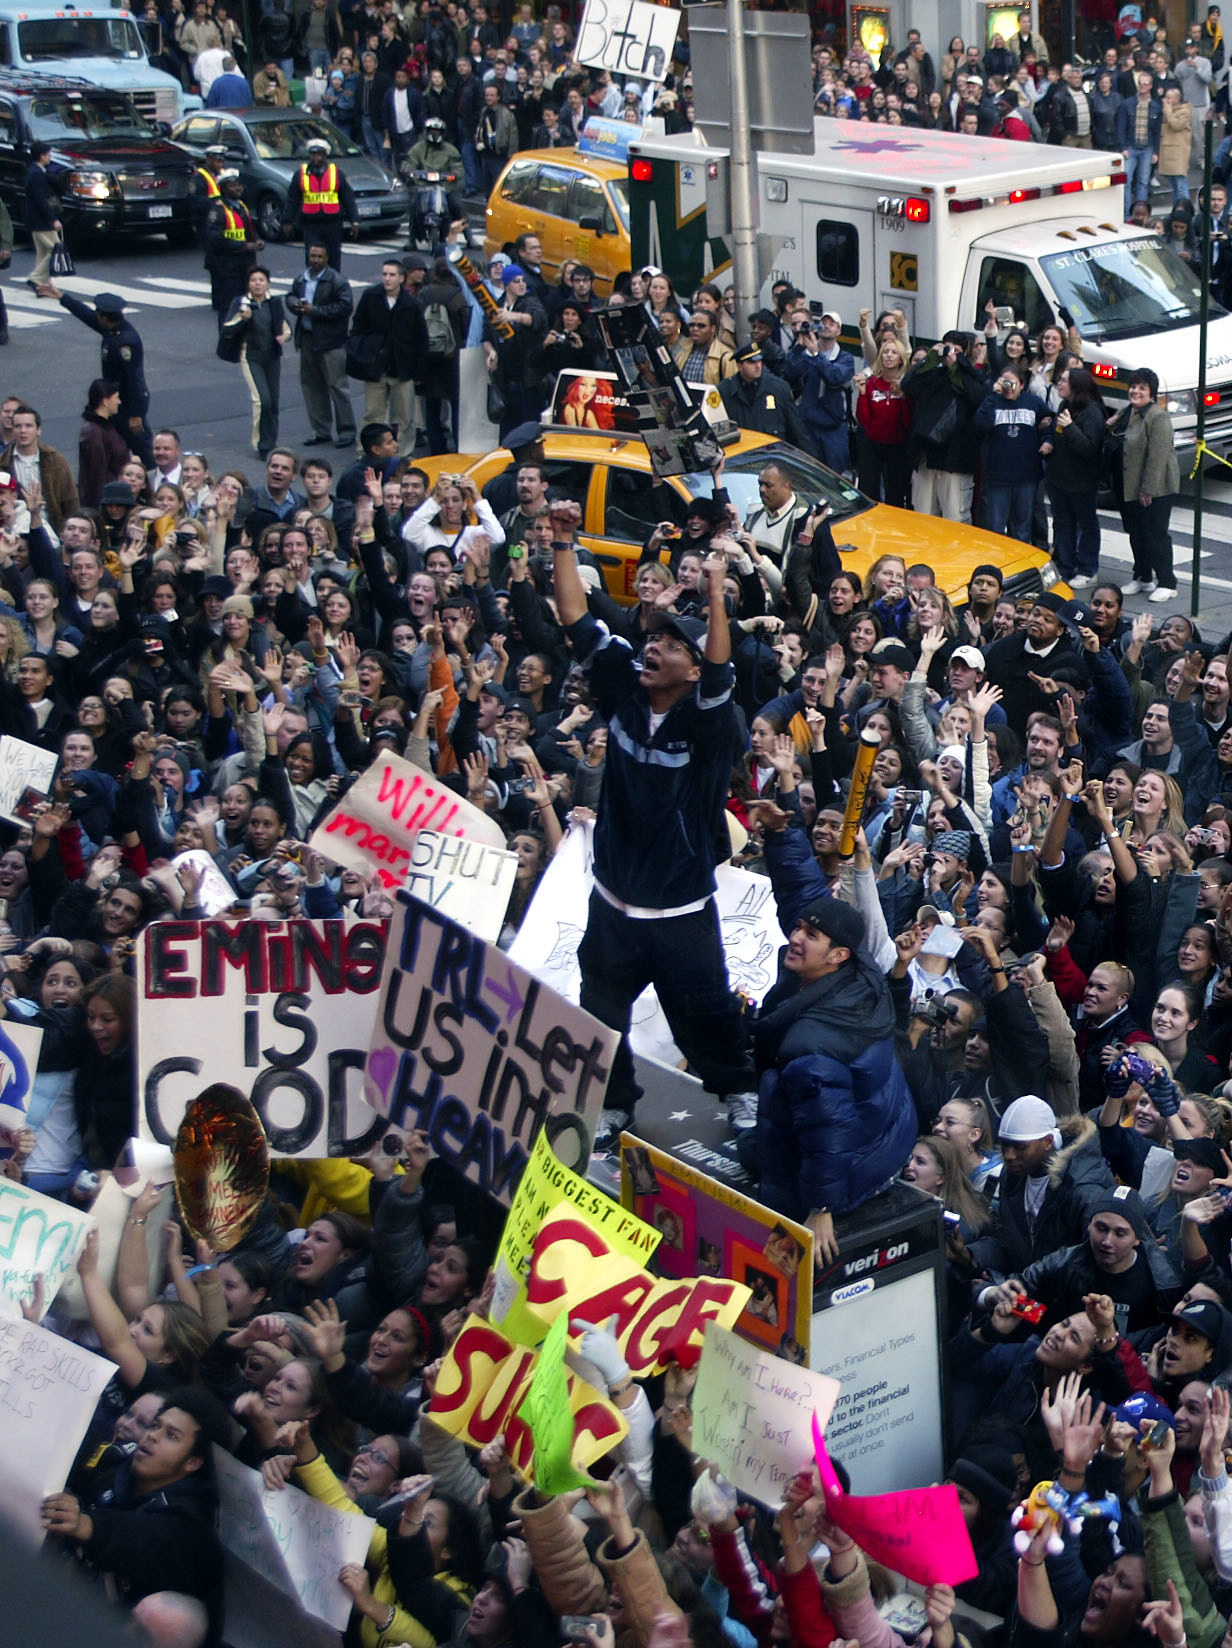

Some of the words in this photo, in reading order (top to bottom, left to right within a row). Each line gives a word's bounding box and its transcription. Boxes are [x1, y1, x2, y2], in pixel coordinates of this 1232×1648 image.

[577, 0, 665, 78] Bitch
[881, 217, 905, 232] 1909
[411, 830, 520, 886] SHUT
[403, 903, 500, 1035] TRL
[541, 1155, 616, 1222] BIGGEST
[616, 1217, 657, 1253] FAN
[844, 1242, 909, 1275] verizon
[527, 1218, 736, 1372] CAGE
[835, 1283, 870, 1300] VIACOM
[844, 1343, 887, 1368] Financial
[888, 1331, 916, 1352] Types
[837, 1409, 847, 1421] to
[849, 1401, 865, 1417] the
[867, 1384, 910, 1409] financial
[853, 1379, 889, 1405] people
[831, 1419, 864, 1438] sector.
[831, 1431, 864, 1454] usually
[890, 1411, 914, 1429] send
